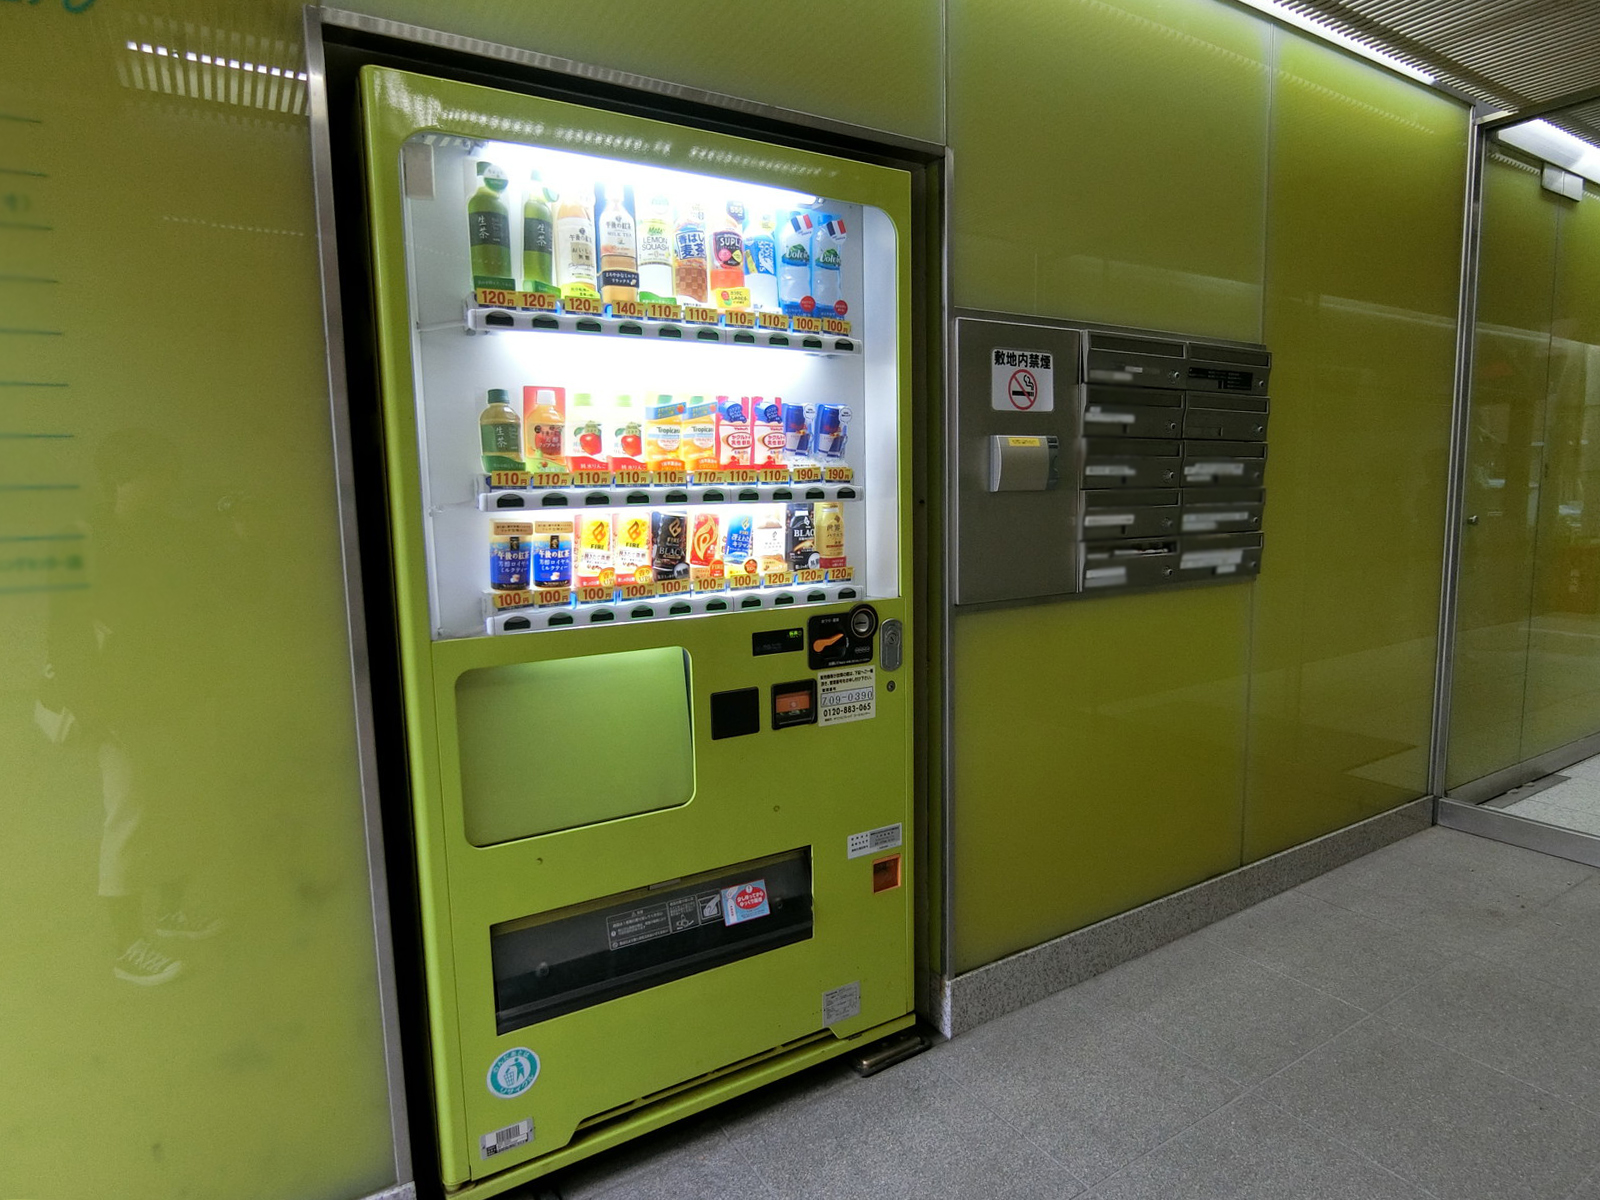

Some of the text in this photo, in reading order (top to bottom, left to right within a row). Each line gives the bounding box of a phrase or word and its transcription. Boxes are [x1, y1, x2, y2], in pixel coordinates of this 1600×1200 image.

[478, 216, 489, 239] 生茶
[537, 224, 547, 247] 生茶
[643, 236, 668, 245] LEMON
[641, 243, 669, 251] SQUASH
[680, 243, 705, 258] 麦茶
[994, 350, 1051, 370] 敷地内禁煙
[496, 426, 507, 448] 生茶
[794, 529, 814, 537] BLAC
[538, 549, 570, 559] 午後の紅茶
[659, 547, 685, 556] BLACK
[823, 702, 871, 717] 0120-883-065
